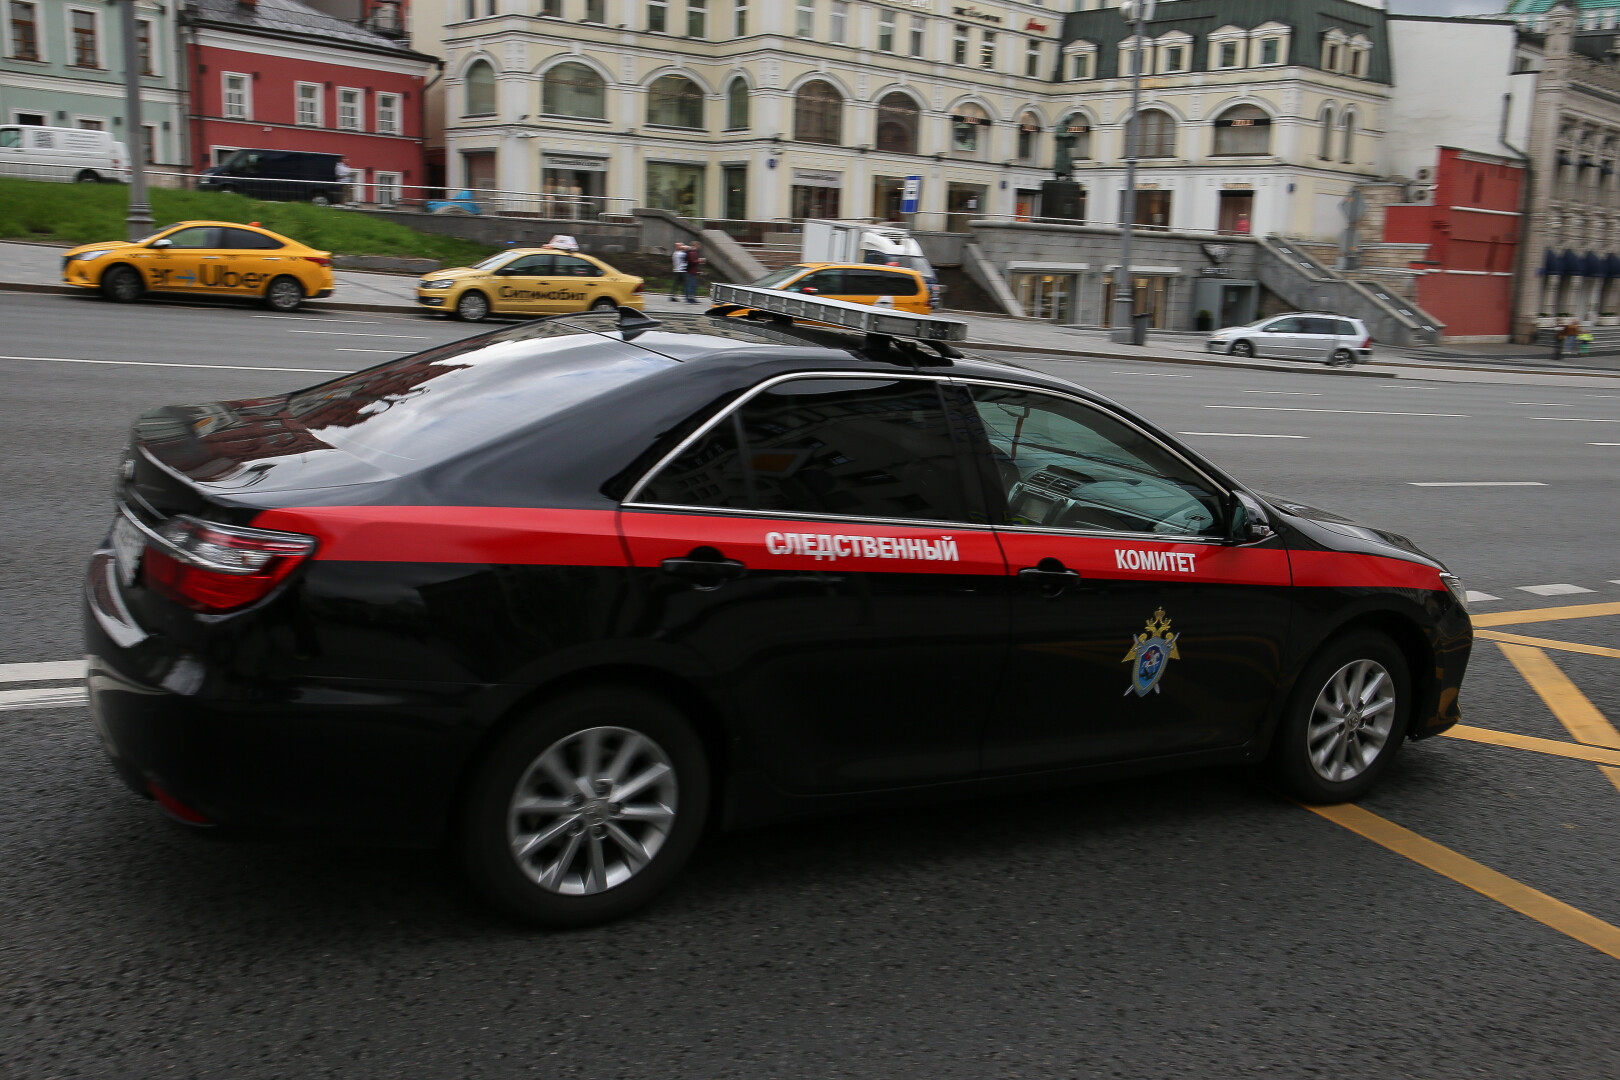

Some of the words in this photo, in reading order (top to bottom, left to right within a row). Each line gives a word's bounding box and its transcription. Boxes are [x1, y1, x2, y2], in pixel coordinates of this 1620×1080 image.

[198, 263, 271, 289] Uber
[765, 531, 960, 562] СЛЕДСТВЕННЫЙ
[1114, 549, 1196, 573] КОМИТЕТ
